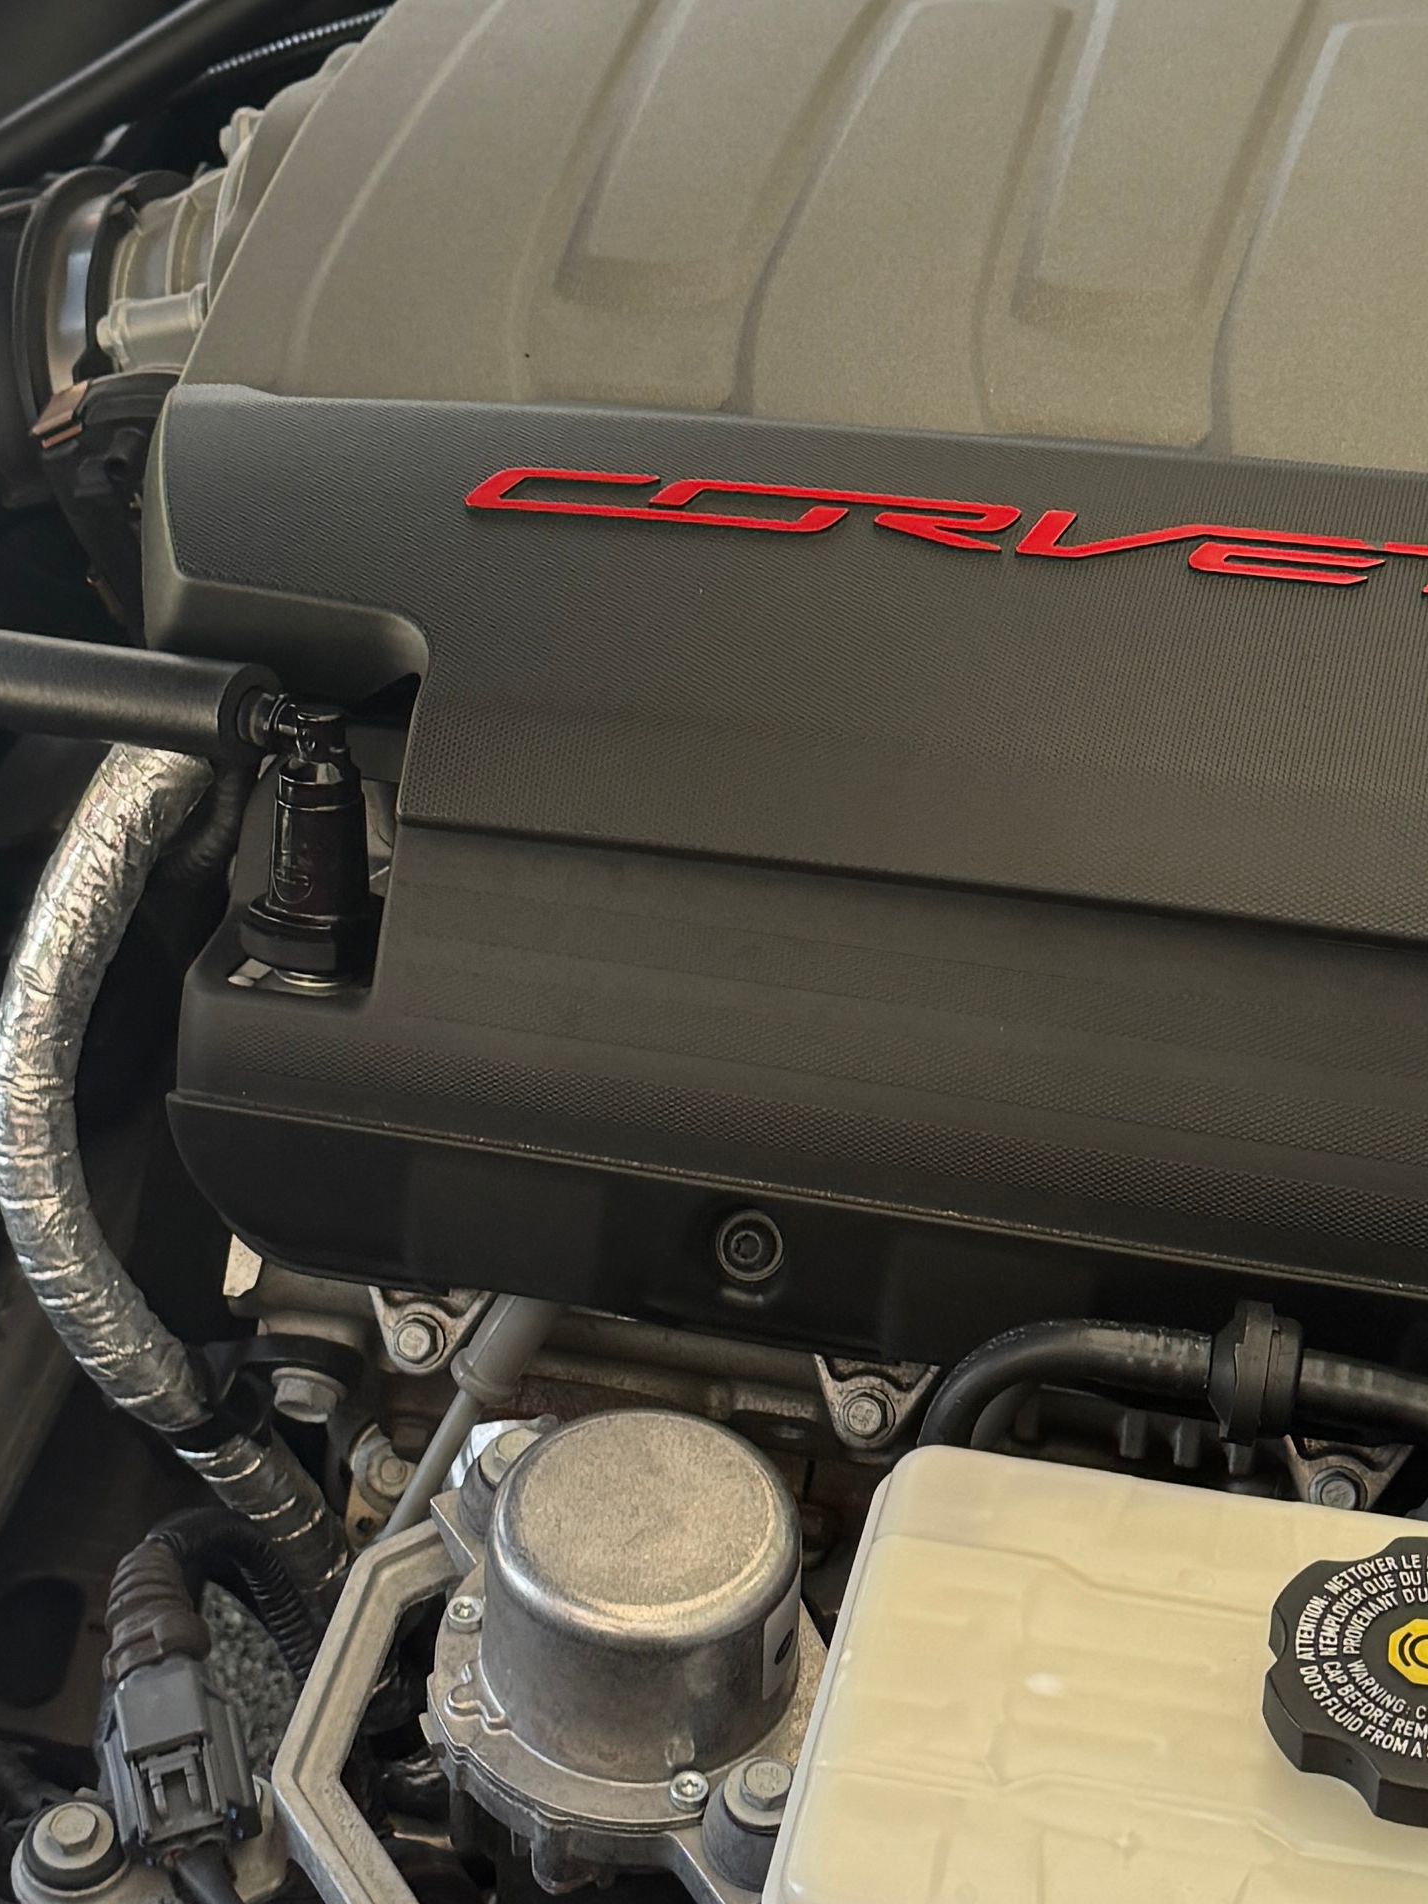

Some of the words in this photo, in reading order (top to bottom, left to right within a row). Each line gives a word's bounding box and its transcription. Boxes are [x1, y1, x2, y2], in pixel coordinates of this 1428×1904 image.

[1323, 1556, 1399, 1595] NETTOYER
[1401, 1554, 1422, 1570] LE
[1362, 1573, 1397, 1595] QUE
[1399, 1570, 1422, 1586] DU
[1342, 1591, 1399, 1654] PROVENANT
[1299, 1665, 1332, 1700] DOT3
[1319, 1697, 1364, 1732] FLUID
[1360, 1724, 1409, 1755] FROM
[1410, 1741, 1423, 1758] A
[1322, 1661, 1348, 1684] CAP
[1336, 1684, 1393, 1728] BEFORE
